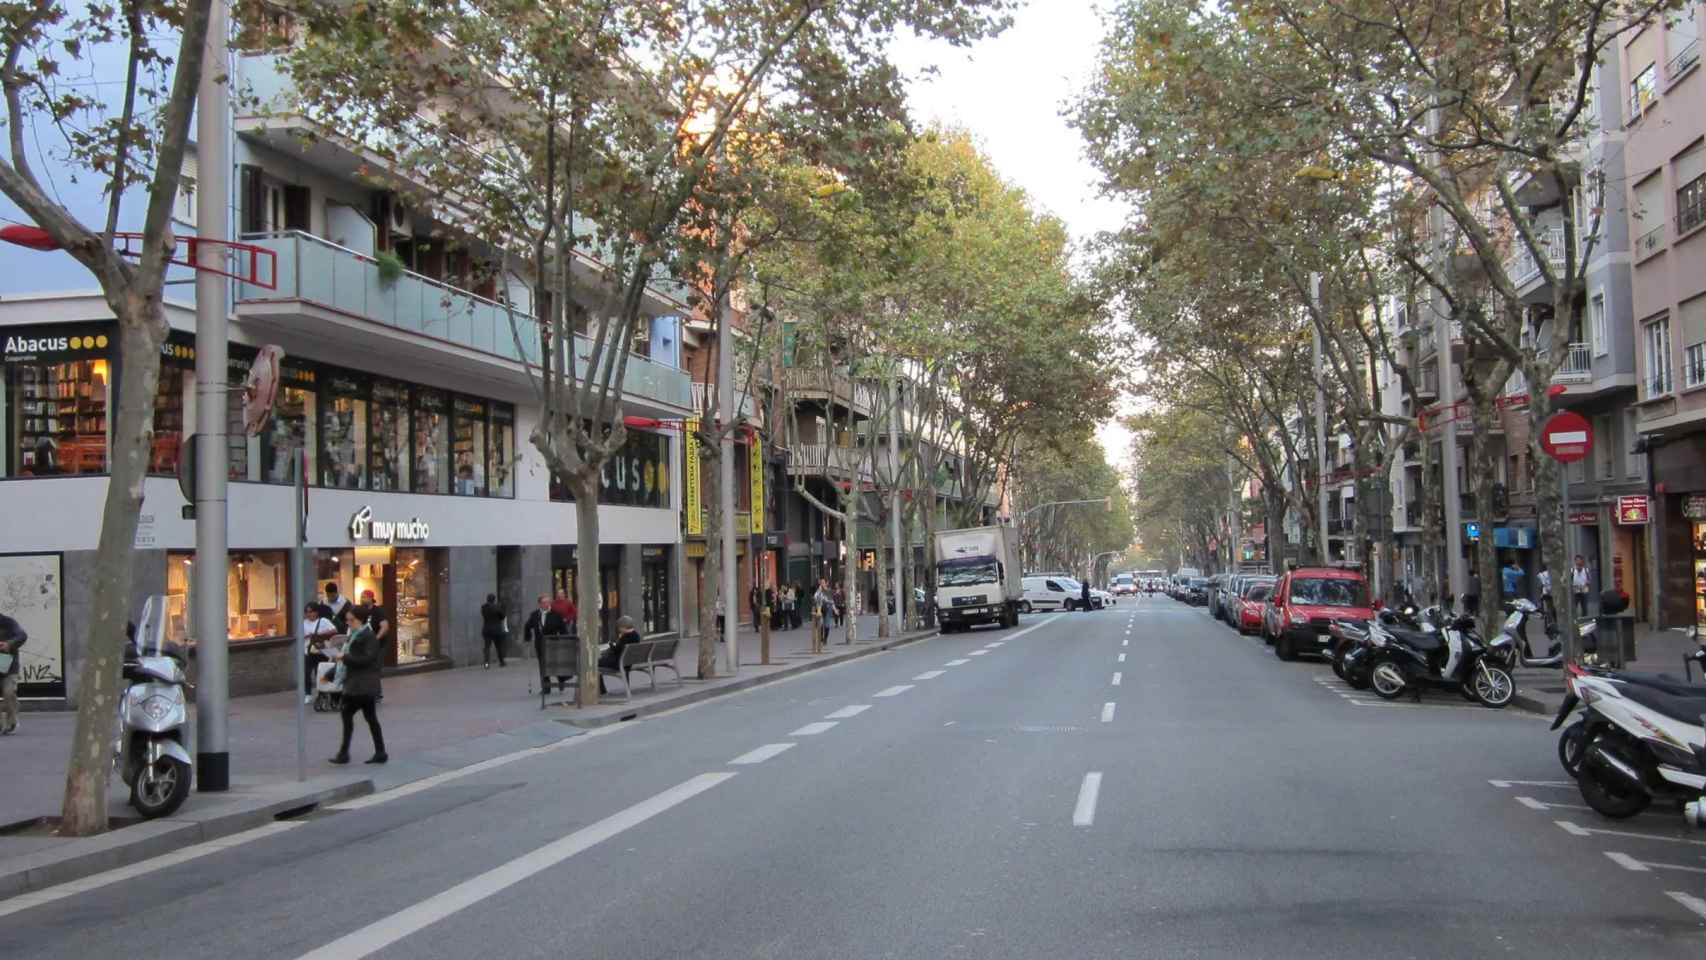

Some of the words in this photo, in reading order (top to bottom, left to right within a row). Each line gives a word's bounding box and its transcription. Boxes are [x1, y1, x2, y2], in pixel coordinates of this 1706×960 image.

[5, 336, 68, 352] Abacus
[372, 521, 395, 544] muy
[397, 517, 429, 539] mucho
